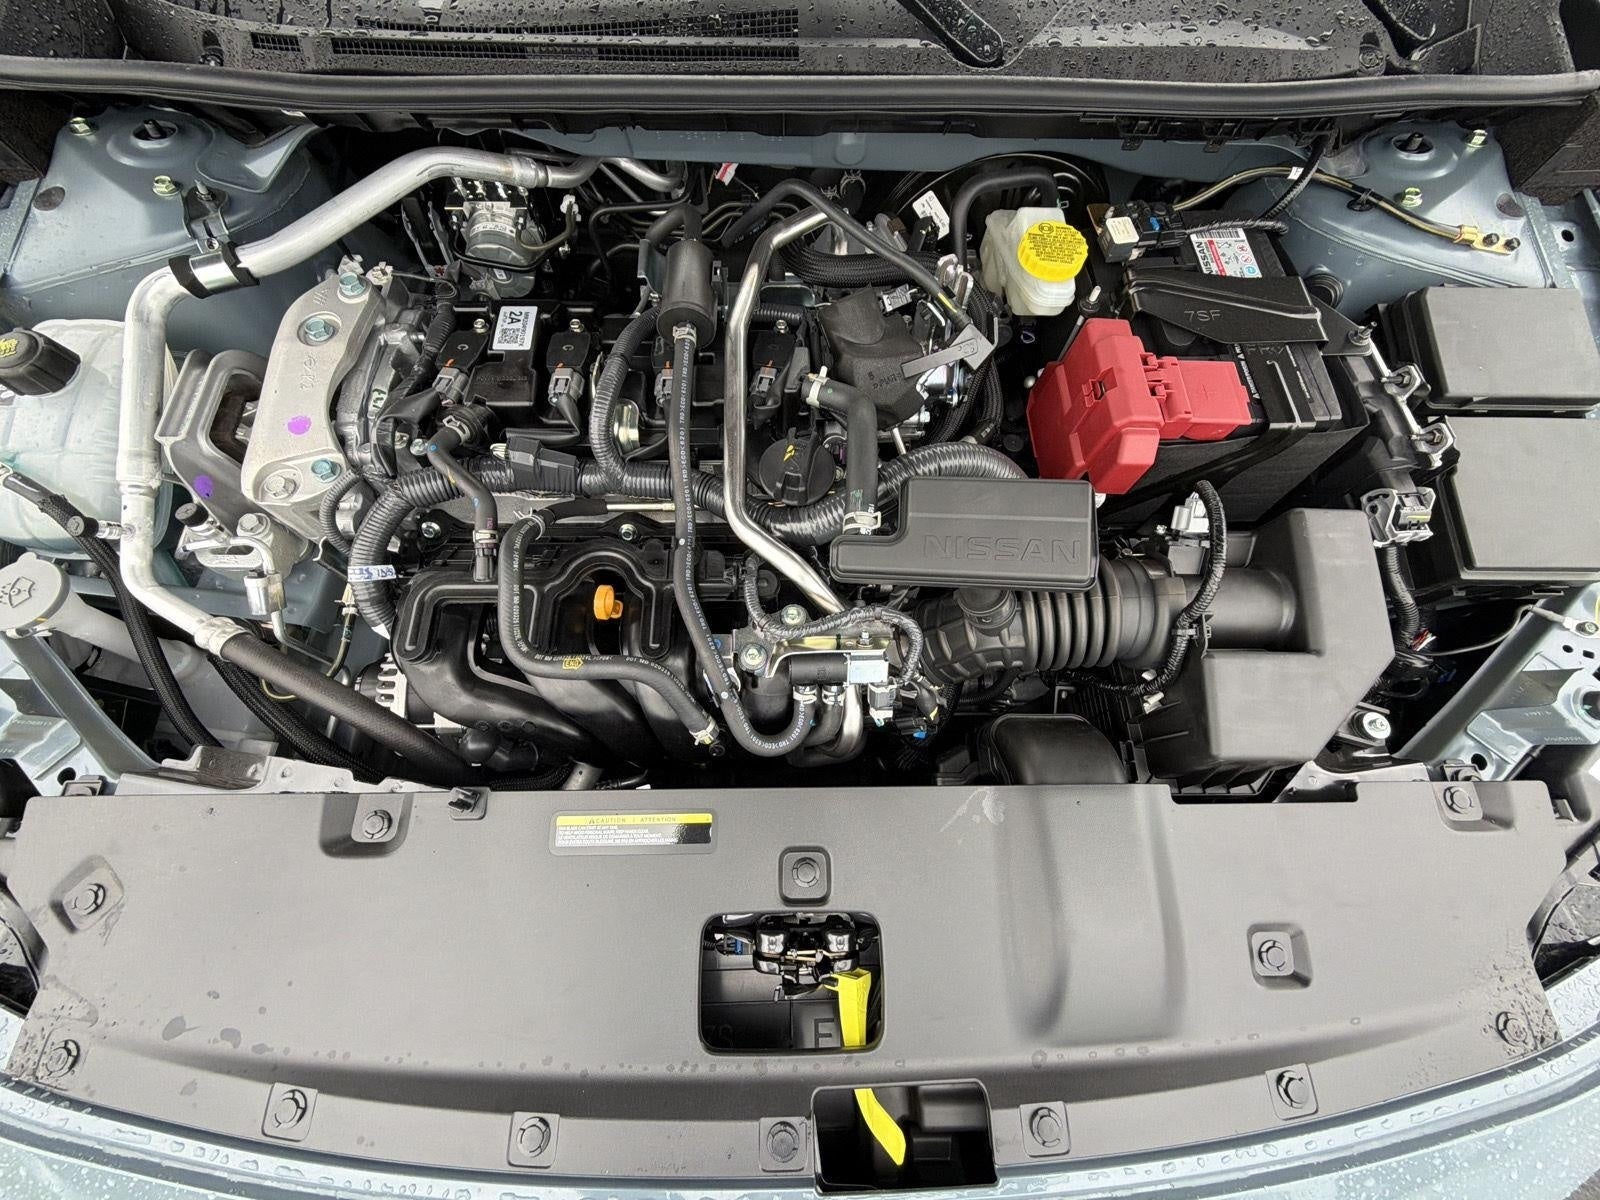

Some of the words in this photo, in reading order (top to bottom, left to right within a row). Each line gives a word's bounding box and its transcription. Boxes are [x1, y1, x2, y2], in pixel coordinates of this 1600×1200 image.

[1195, 241, 1213, 275] NISSAN
[507, 311, 523, 325] 2A
[922, 534, 1081, 565] NISSAN
[595, 816, 627, 824] CAUTION
[640, 815, 677, 823] ATTENTION
